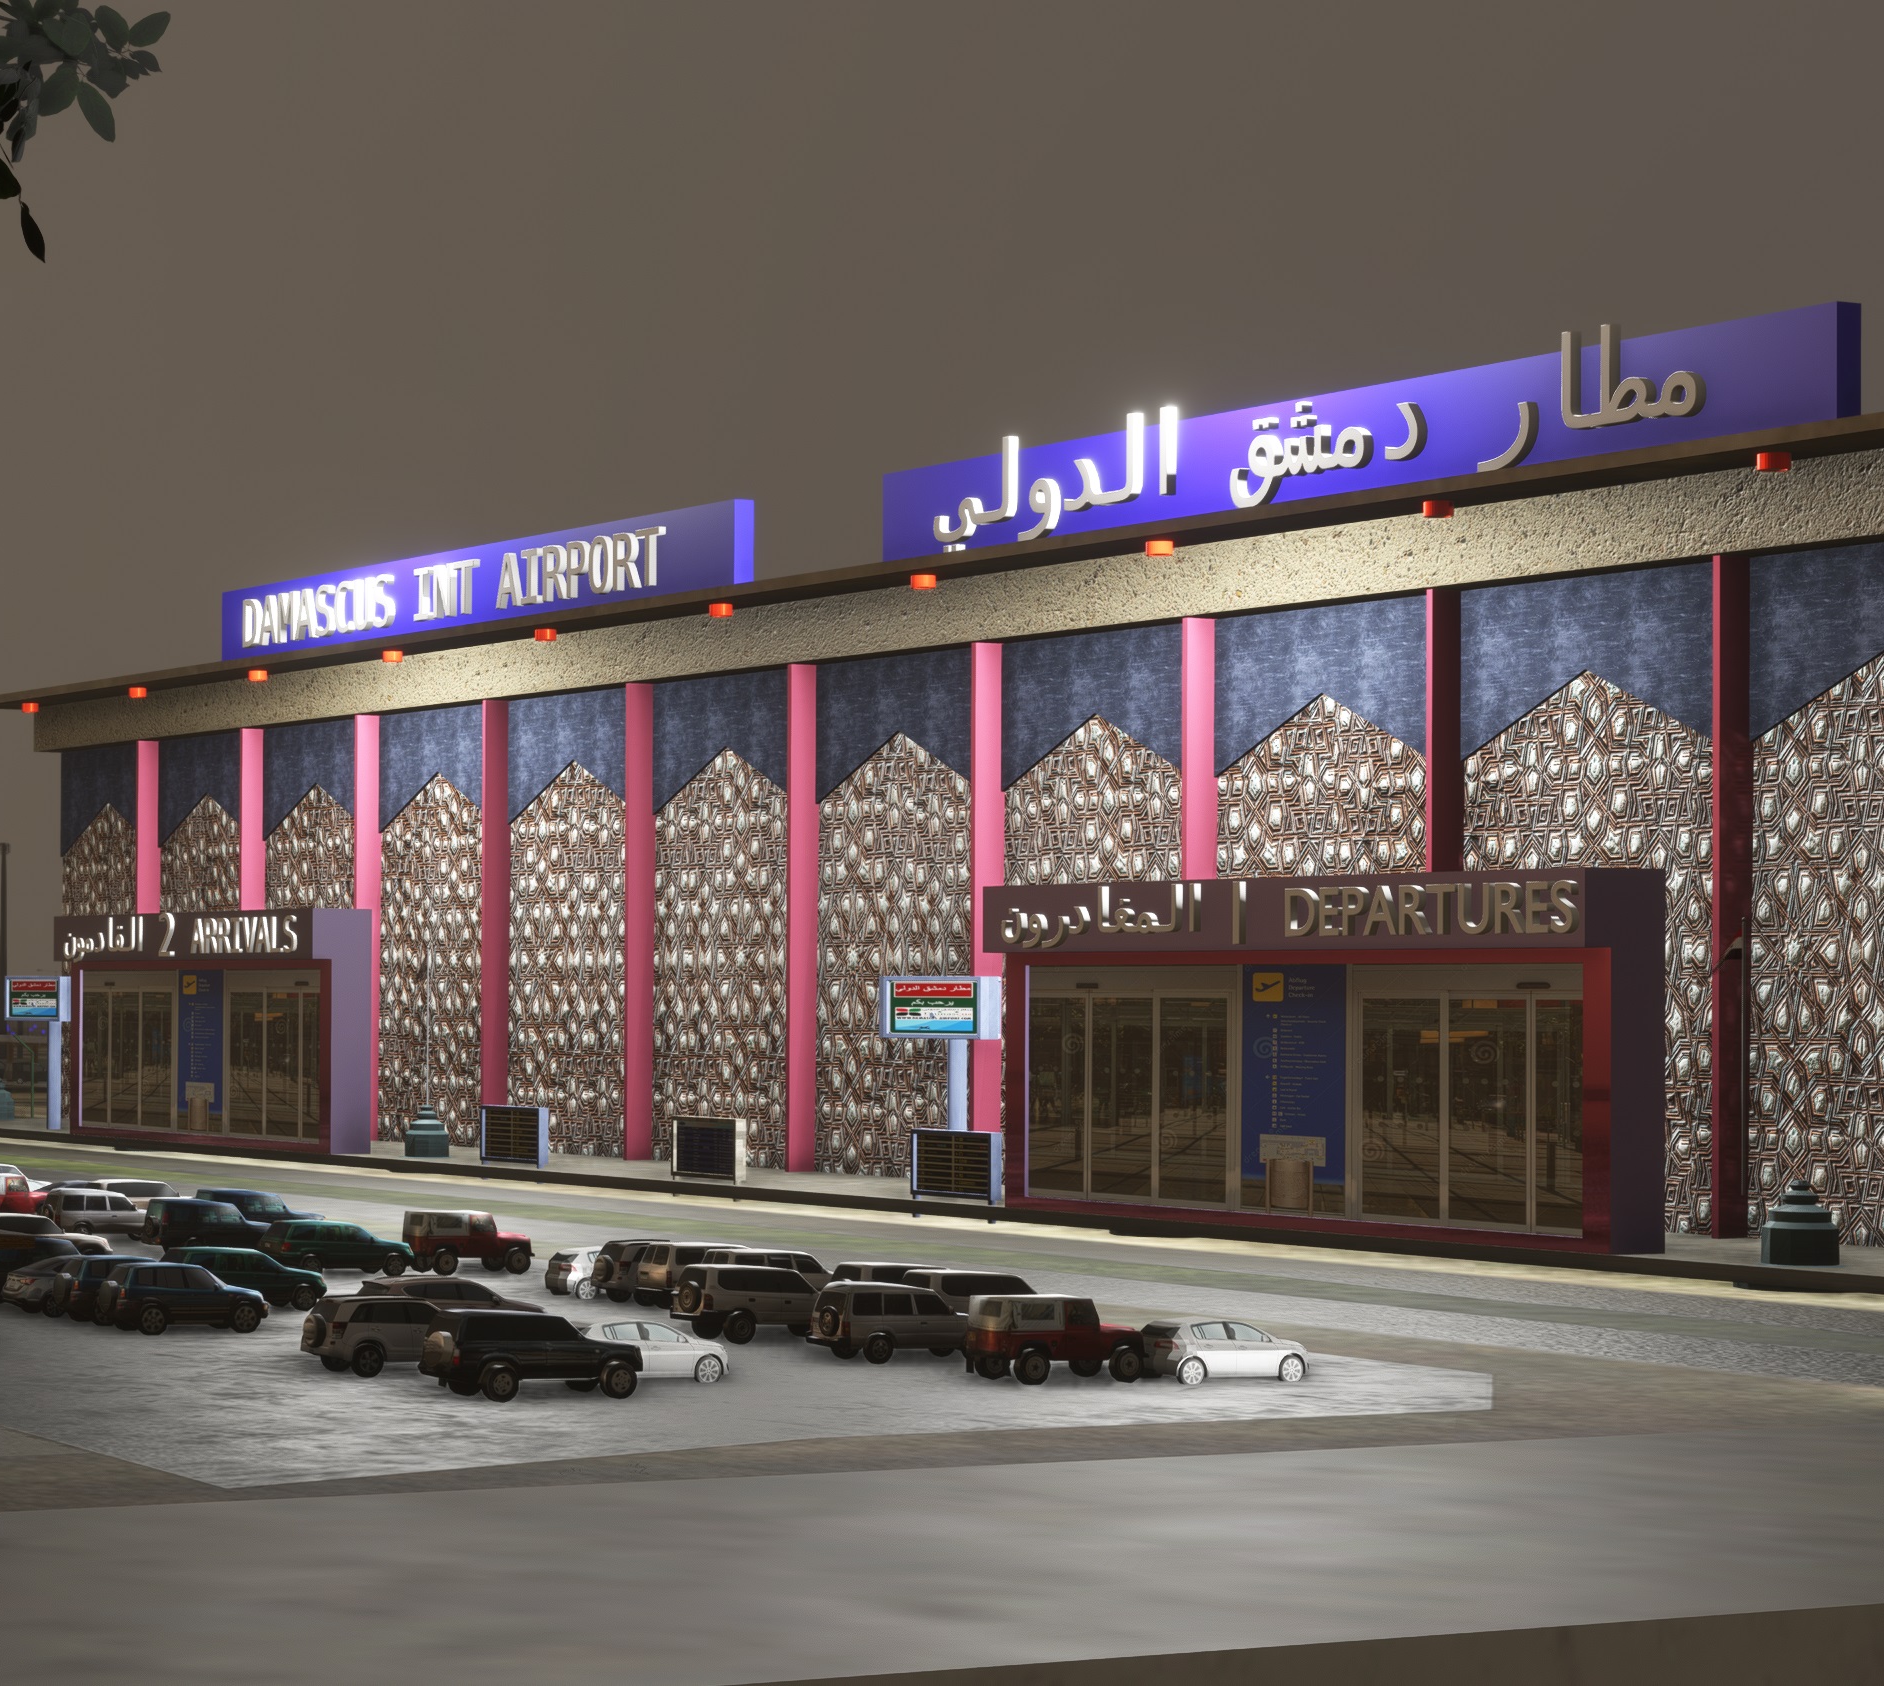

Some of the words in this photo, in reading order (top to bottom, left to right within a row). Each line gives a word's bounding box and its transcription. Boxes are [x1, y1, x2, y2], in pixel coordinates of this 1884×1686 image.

[1476, 323, 1707, 473] مطار
[932, 405, 1179, 553] الدولي
[1229, 401, 1428, 508] دمشق
[241, 573, 397, 648] DAMASCUS
[413, 558, 480, 622] INT
[495, 525, 667, 610] AIRPORT
[63, 915, 144, 963] القادمون
[157, 912, 176, 957] 2
[190, 914, 298, 954] ARRIVALS
[1000, 882, 1202, 949] المغادرون
[1284, 879, 1581, 938] DEPARTURES
